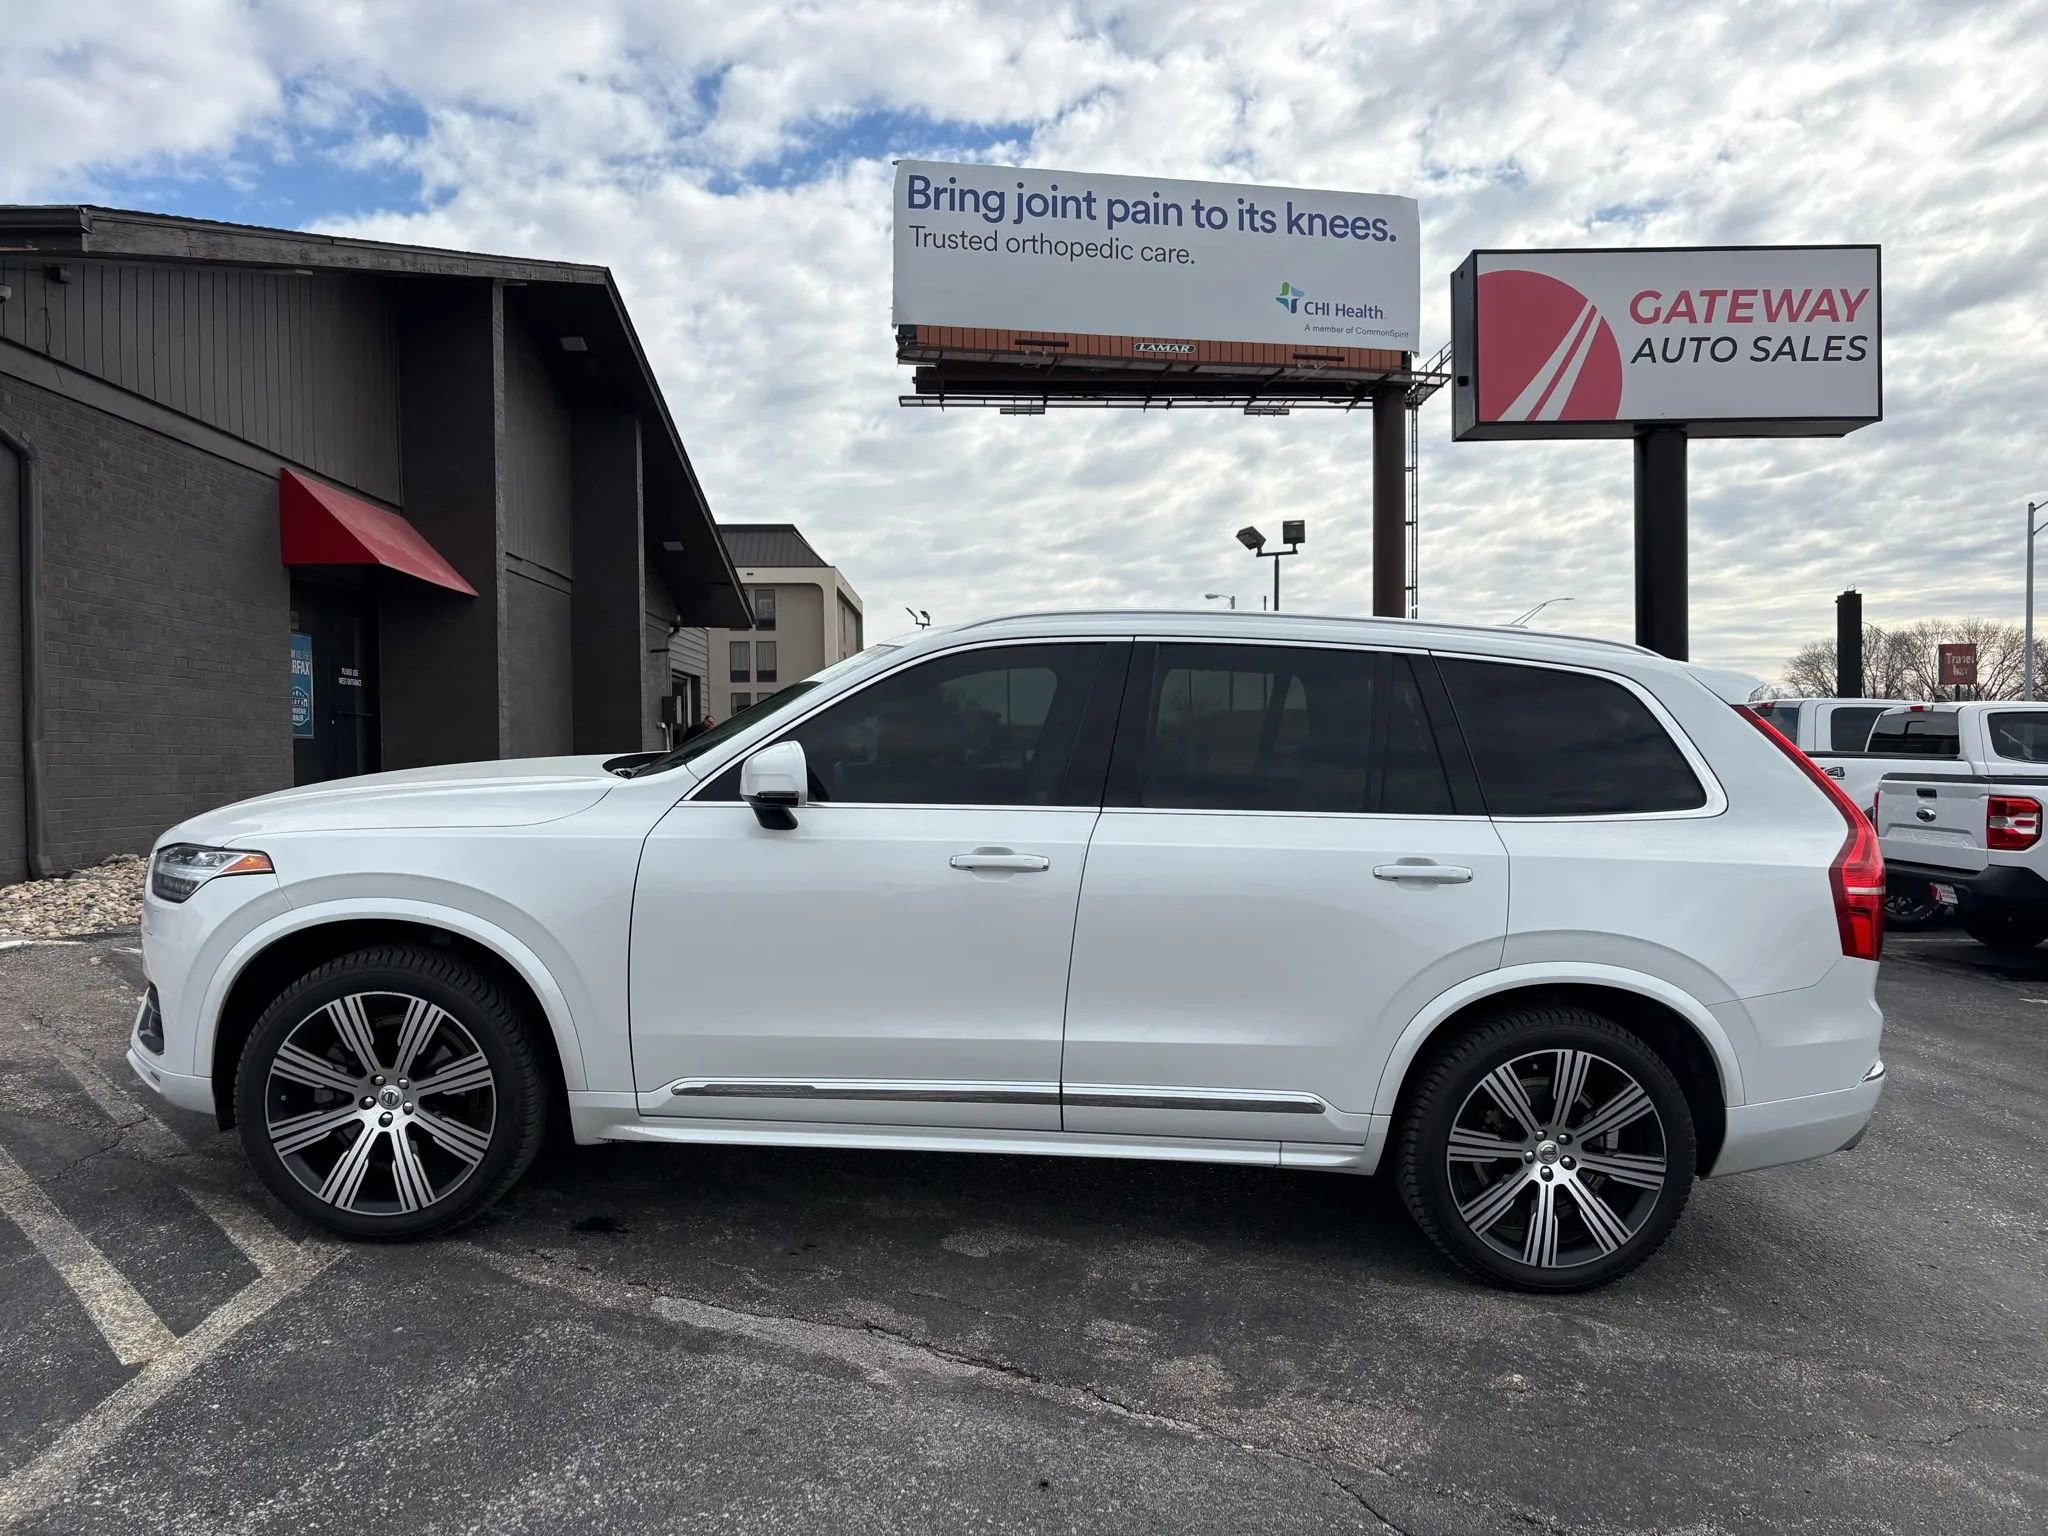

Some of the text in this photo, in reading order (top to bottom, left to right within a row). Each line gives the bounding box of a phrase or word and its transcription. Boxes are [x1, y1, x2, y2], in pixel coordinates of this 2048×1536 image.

[908, 175, 1397, 243] Bring joint pain to its knees.
[908, 225, 1195, 265] Trusted orthopedic care.
[1304, 301, 1384, 320] CHI Health
[1629, 288, 1870, 325] GATEWAY
[1304, 324, 1409, 339] A member of CommonSpirit
[1139, 343, 1190, 353] LAMAR
[1631, 335, 1869, 364] AUTO SALES
[290, 659, 310, 676] RFAX
[1945, 652, 1975, 665] Travel
